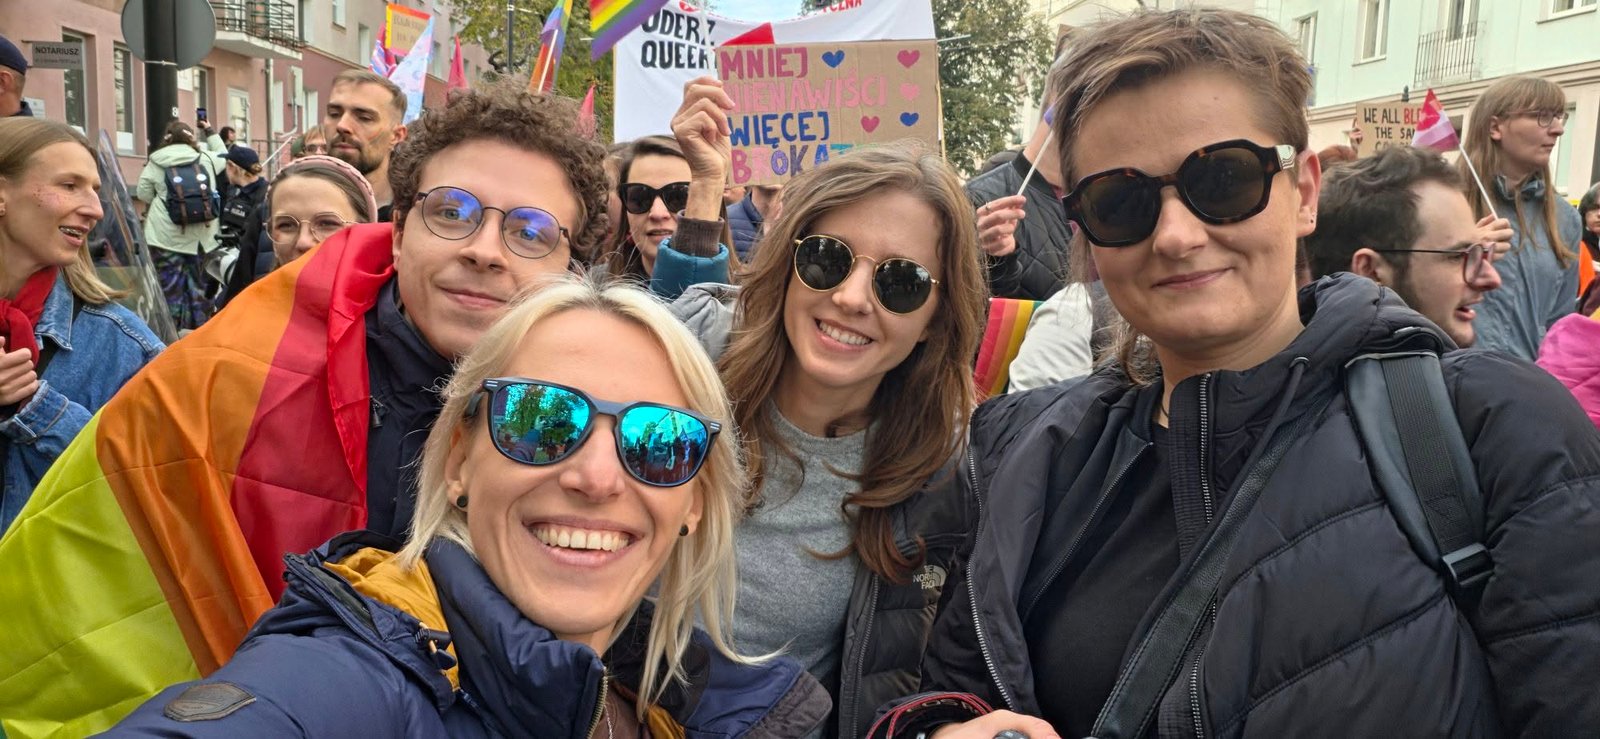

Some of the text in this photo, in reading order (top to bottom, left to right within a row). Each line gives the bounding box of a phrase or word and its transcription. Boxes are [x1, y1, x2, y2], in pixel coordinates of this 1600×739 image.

[35, 46, 80, 56] NOTARIUSZ
[720, 47, 809, 81] MNIEJ
[722, 67, 888, 115] NIENAWIŚCI
[1363, 107, 1378, 124] WE
[1381, 108, 1400, 124] ALL
[727, 111, 830, 149] WIĘCEJ
[1375, 126, 1393, 139] THE
